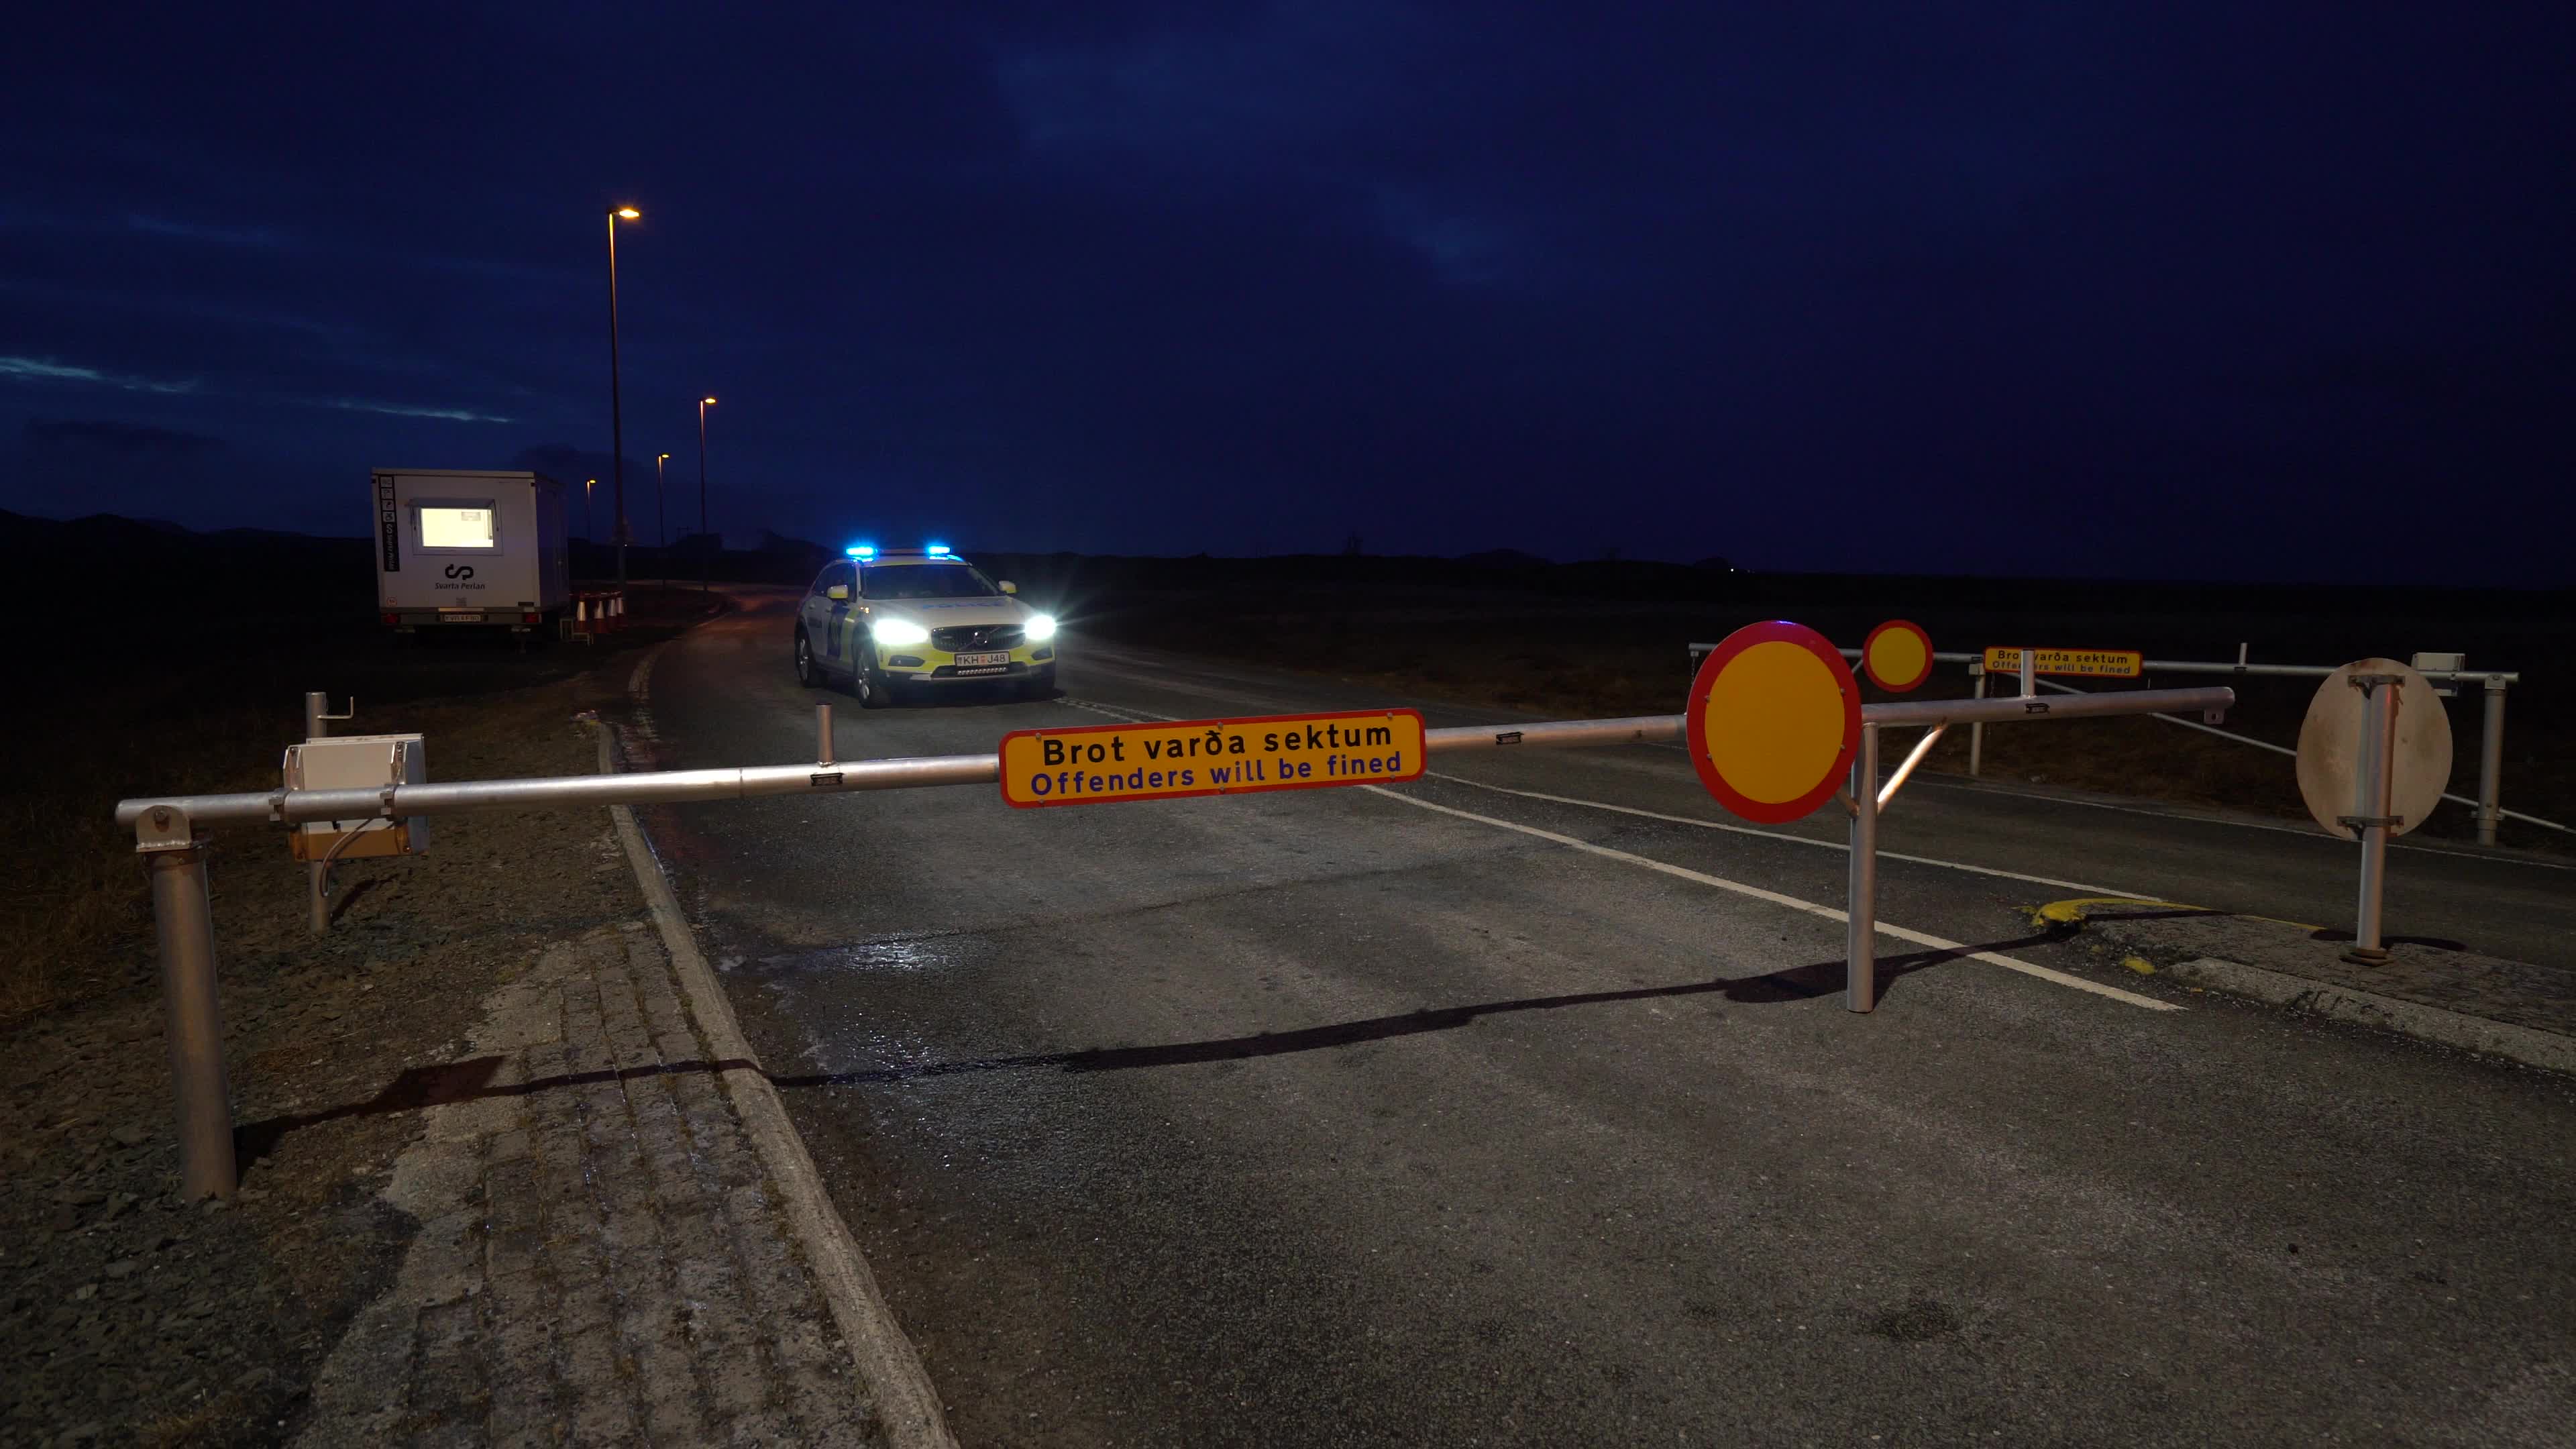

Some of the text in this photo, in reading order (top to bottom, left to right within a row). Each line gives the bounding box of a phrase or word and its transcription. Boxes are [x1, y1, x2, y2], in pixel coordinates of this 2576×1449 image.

[461, 582, 486, 590] Perlan
[963, 654, 1006, 665] KH J48
[1998, 650, 2019, 659] Bro
[2076, 653, 2127, 663] sektum
[2055, 663, 2074, 672] will
[2081, 664, 2093, 672] be
[2100, 665, 2131, 674] fined
[1043, 723, 1391, 766] Brot varða sektum
[1030, 751, 1401, 796] Offenders will be fined
